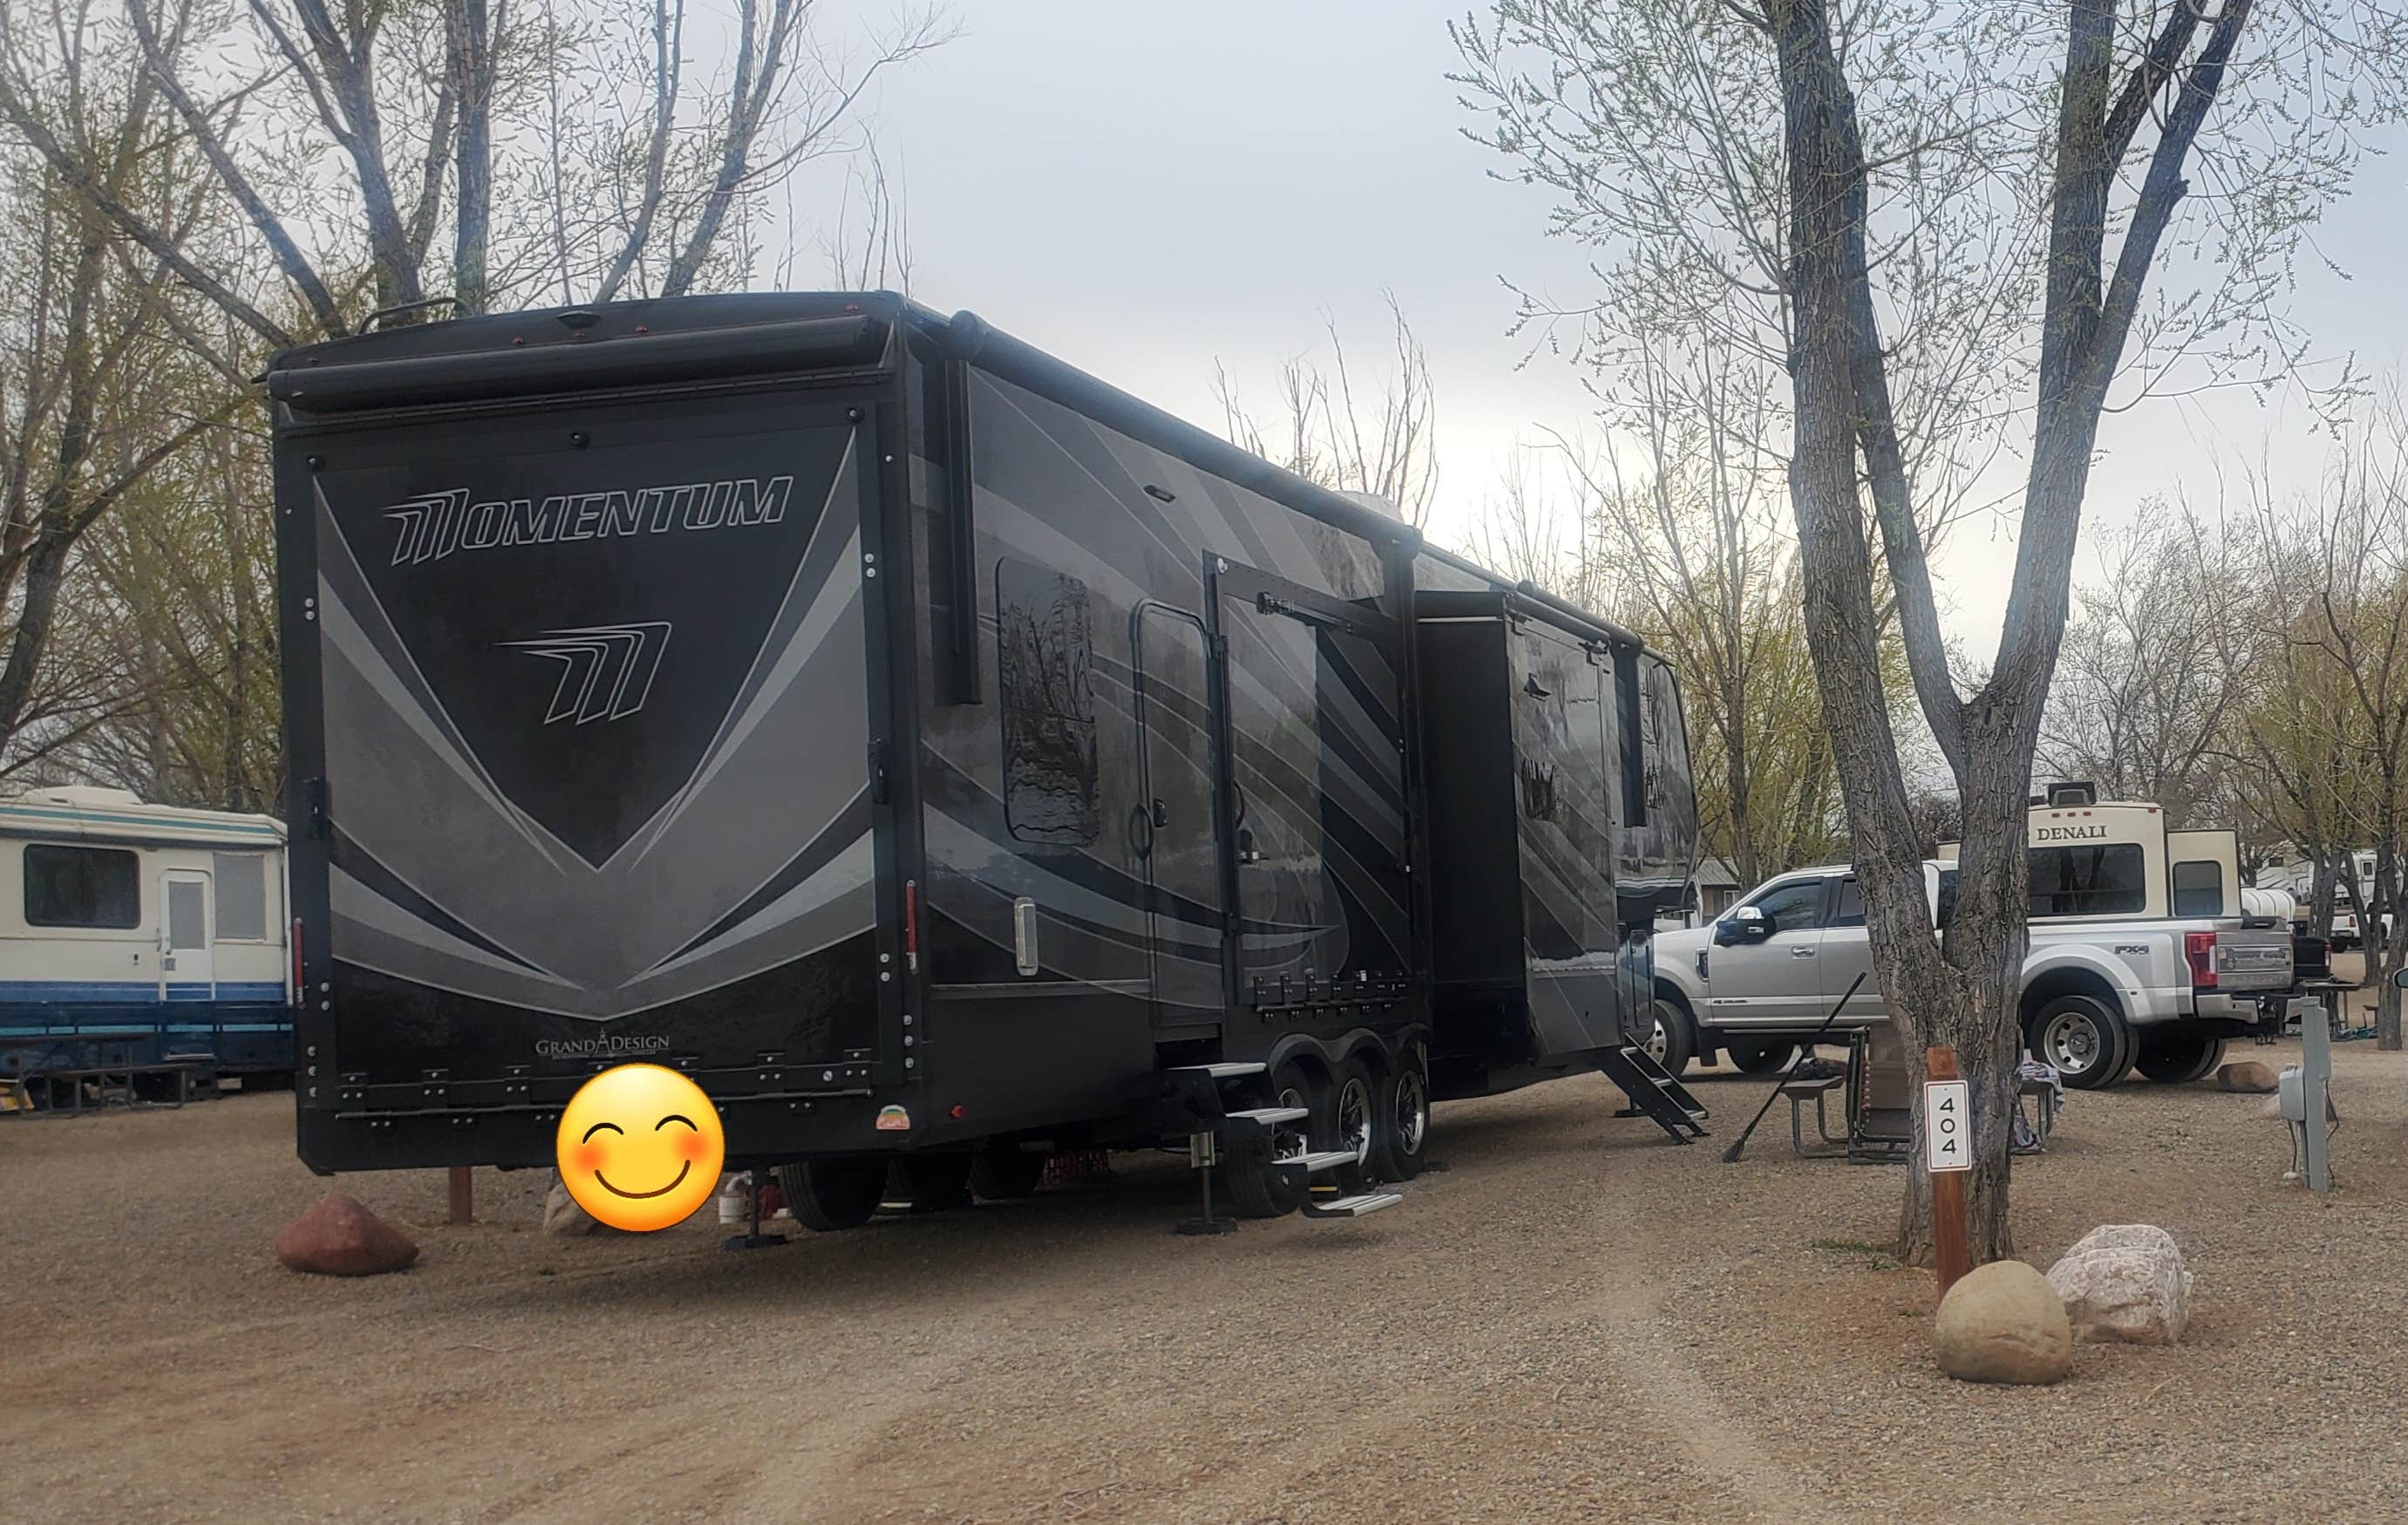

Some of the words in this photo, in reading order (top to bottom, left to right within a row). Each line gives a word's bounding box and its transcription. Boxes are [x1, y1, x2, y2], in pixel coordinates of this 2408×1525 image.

[382, 475, 794, 566] MOMENTUM
[2037, 825, 2107, 841] DENALI
[535, 1039, 596, 1054] GRAND
[611, 1035, 670, 1051] DESIGN
[1940, 1097, 1957, 1154] 404
